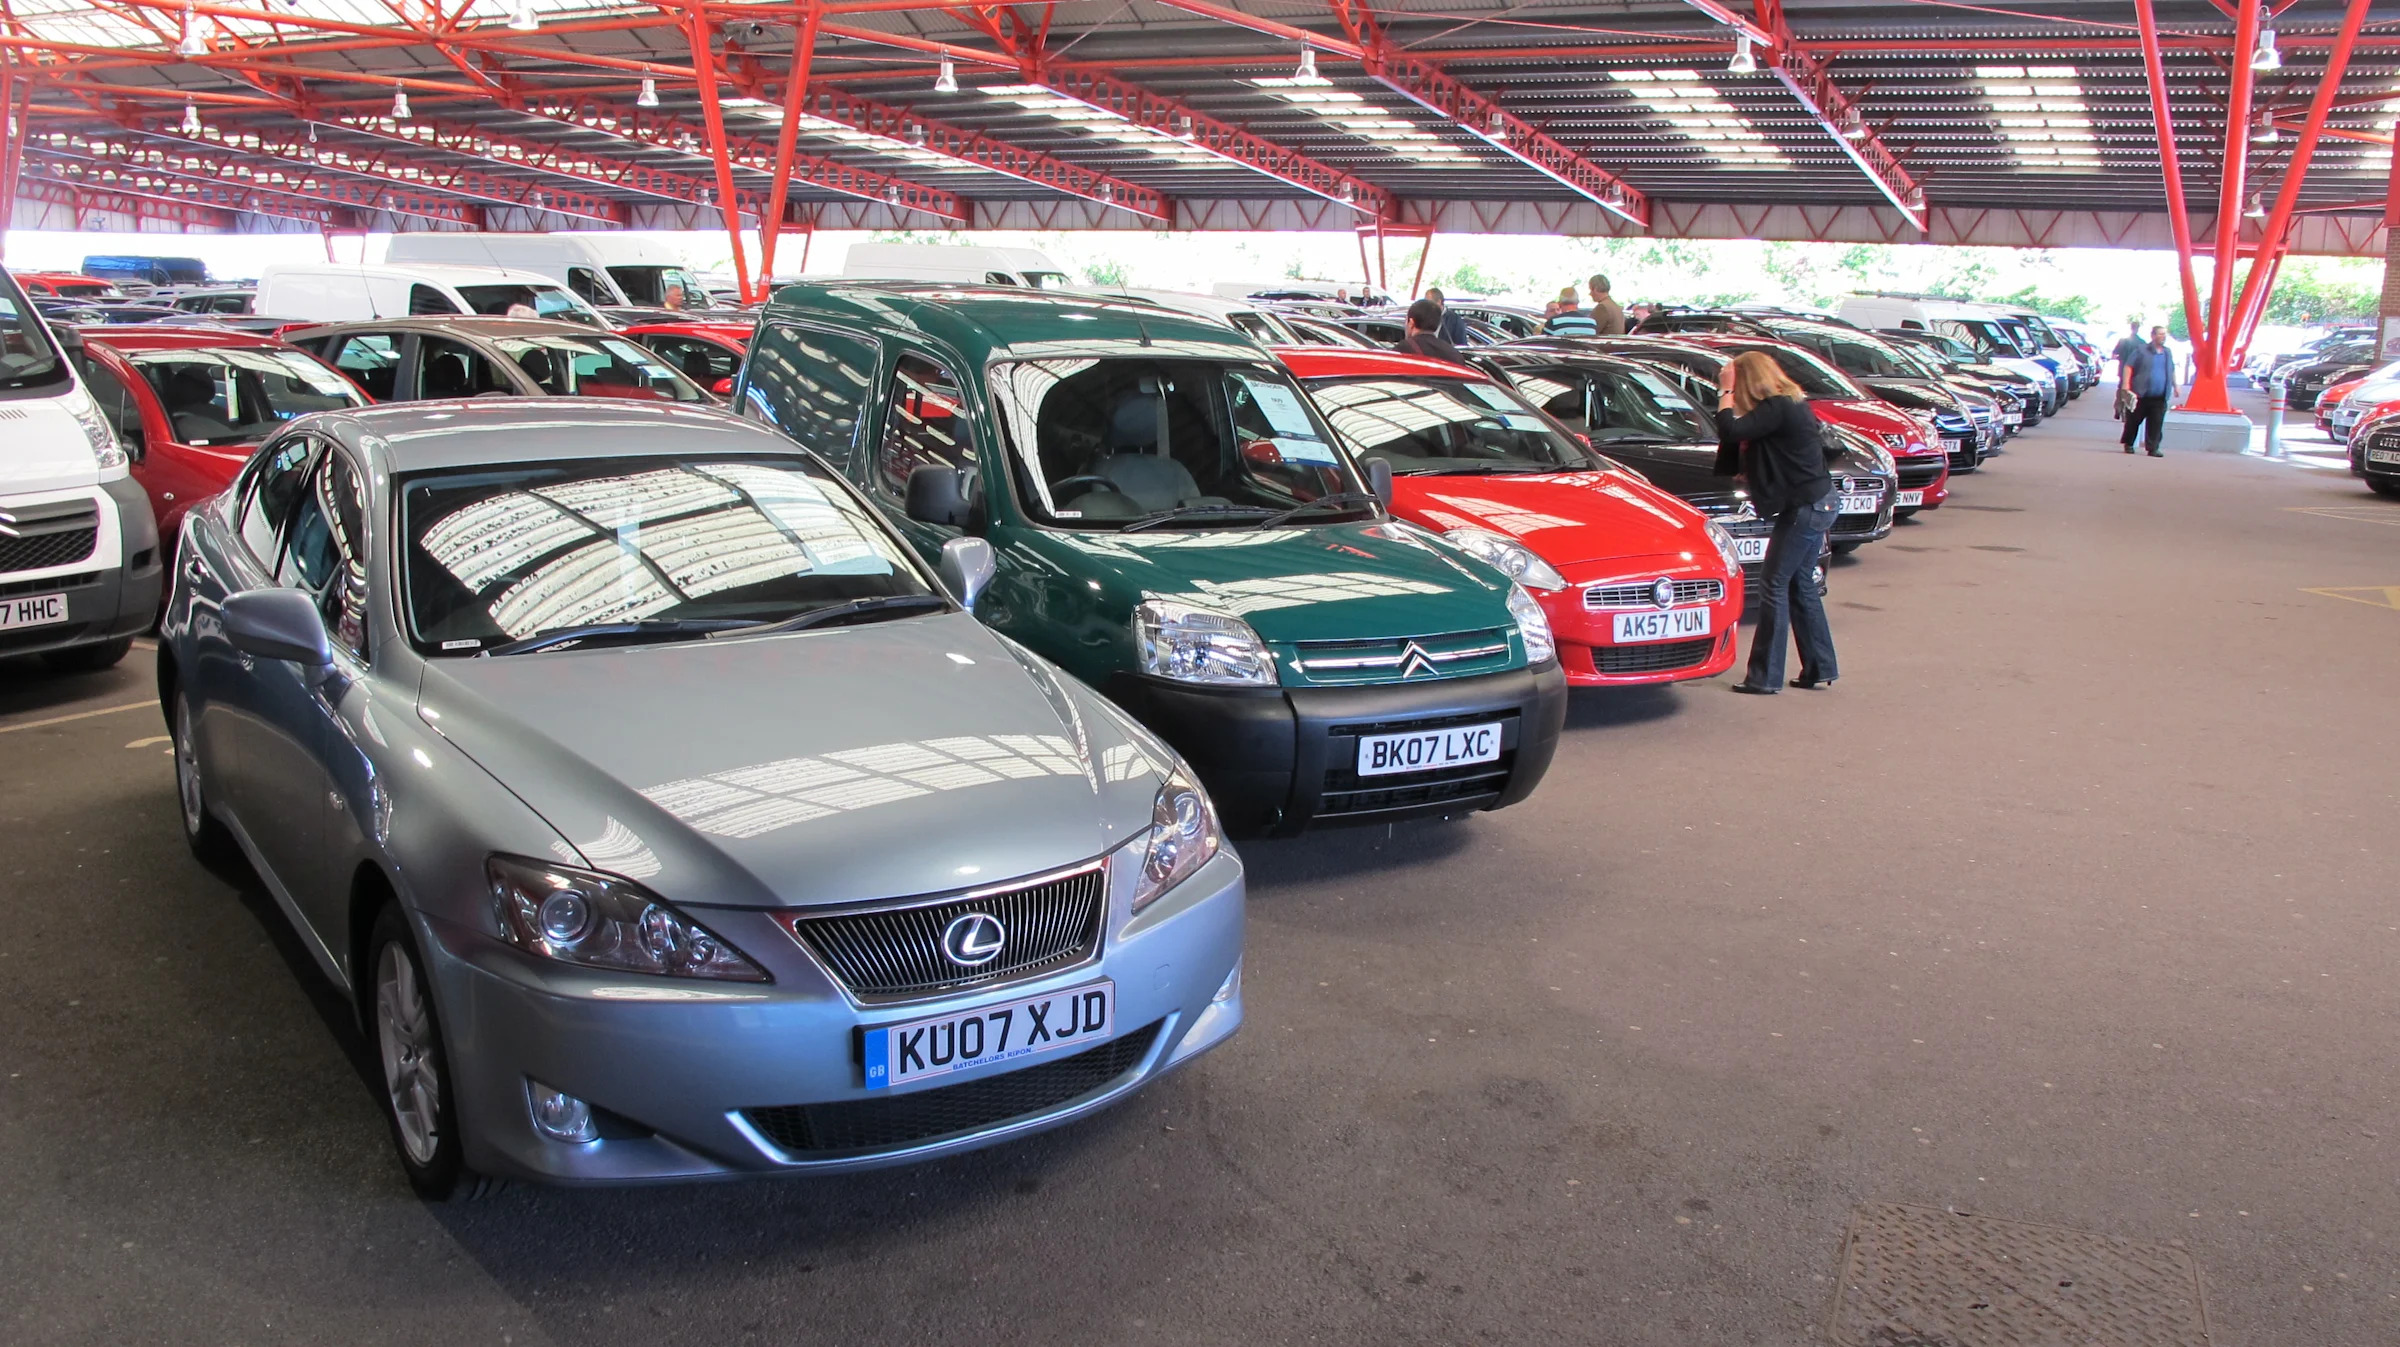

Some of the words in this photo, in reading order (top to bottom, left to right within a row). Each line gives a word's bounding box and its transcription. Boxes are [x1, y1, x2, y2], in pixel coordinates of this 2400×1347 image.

[18, 598, 59, 622] HHC
[1622, 613, 1669, 638] AK57
[1674, 610, 1704, 633] YUN
[1371, 735, 1440, 769] BK07
[1445, 729, 1491, 760] LXC
[899, 1009, 1013, 1074] KU07
[1027, 990, 1106, 1046] XJD
[869, 1065, 885, 1078] GB
[952, 1053, 1005, 1071] BATCHELORS
[1007, 1047, 1032, 1058] RIPON
